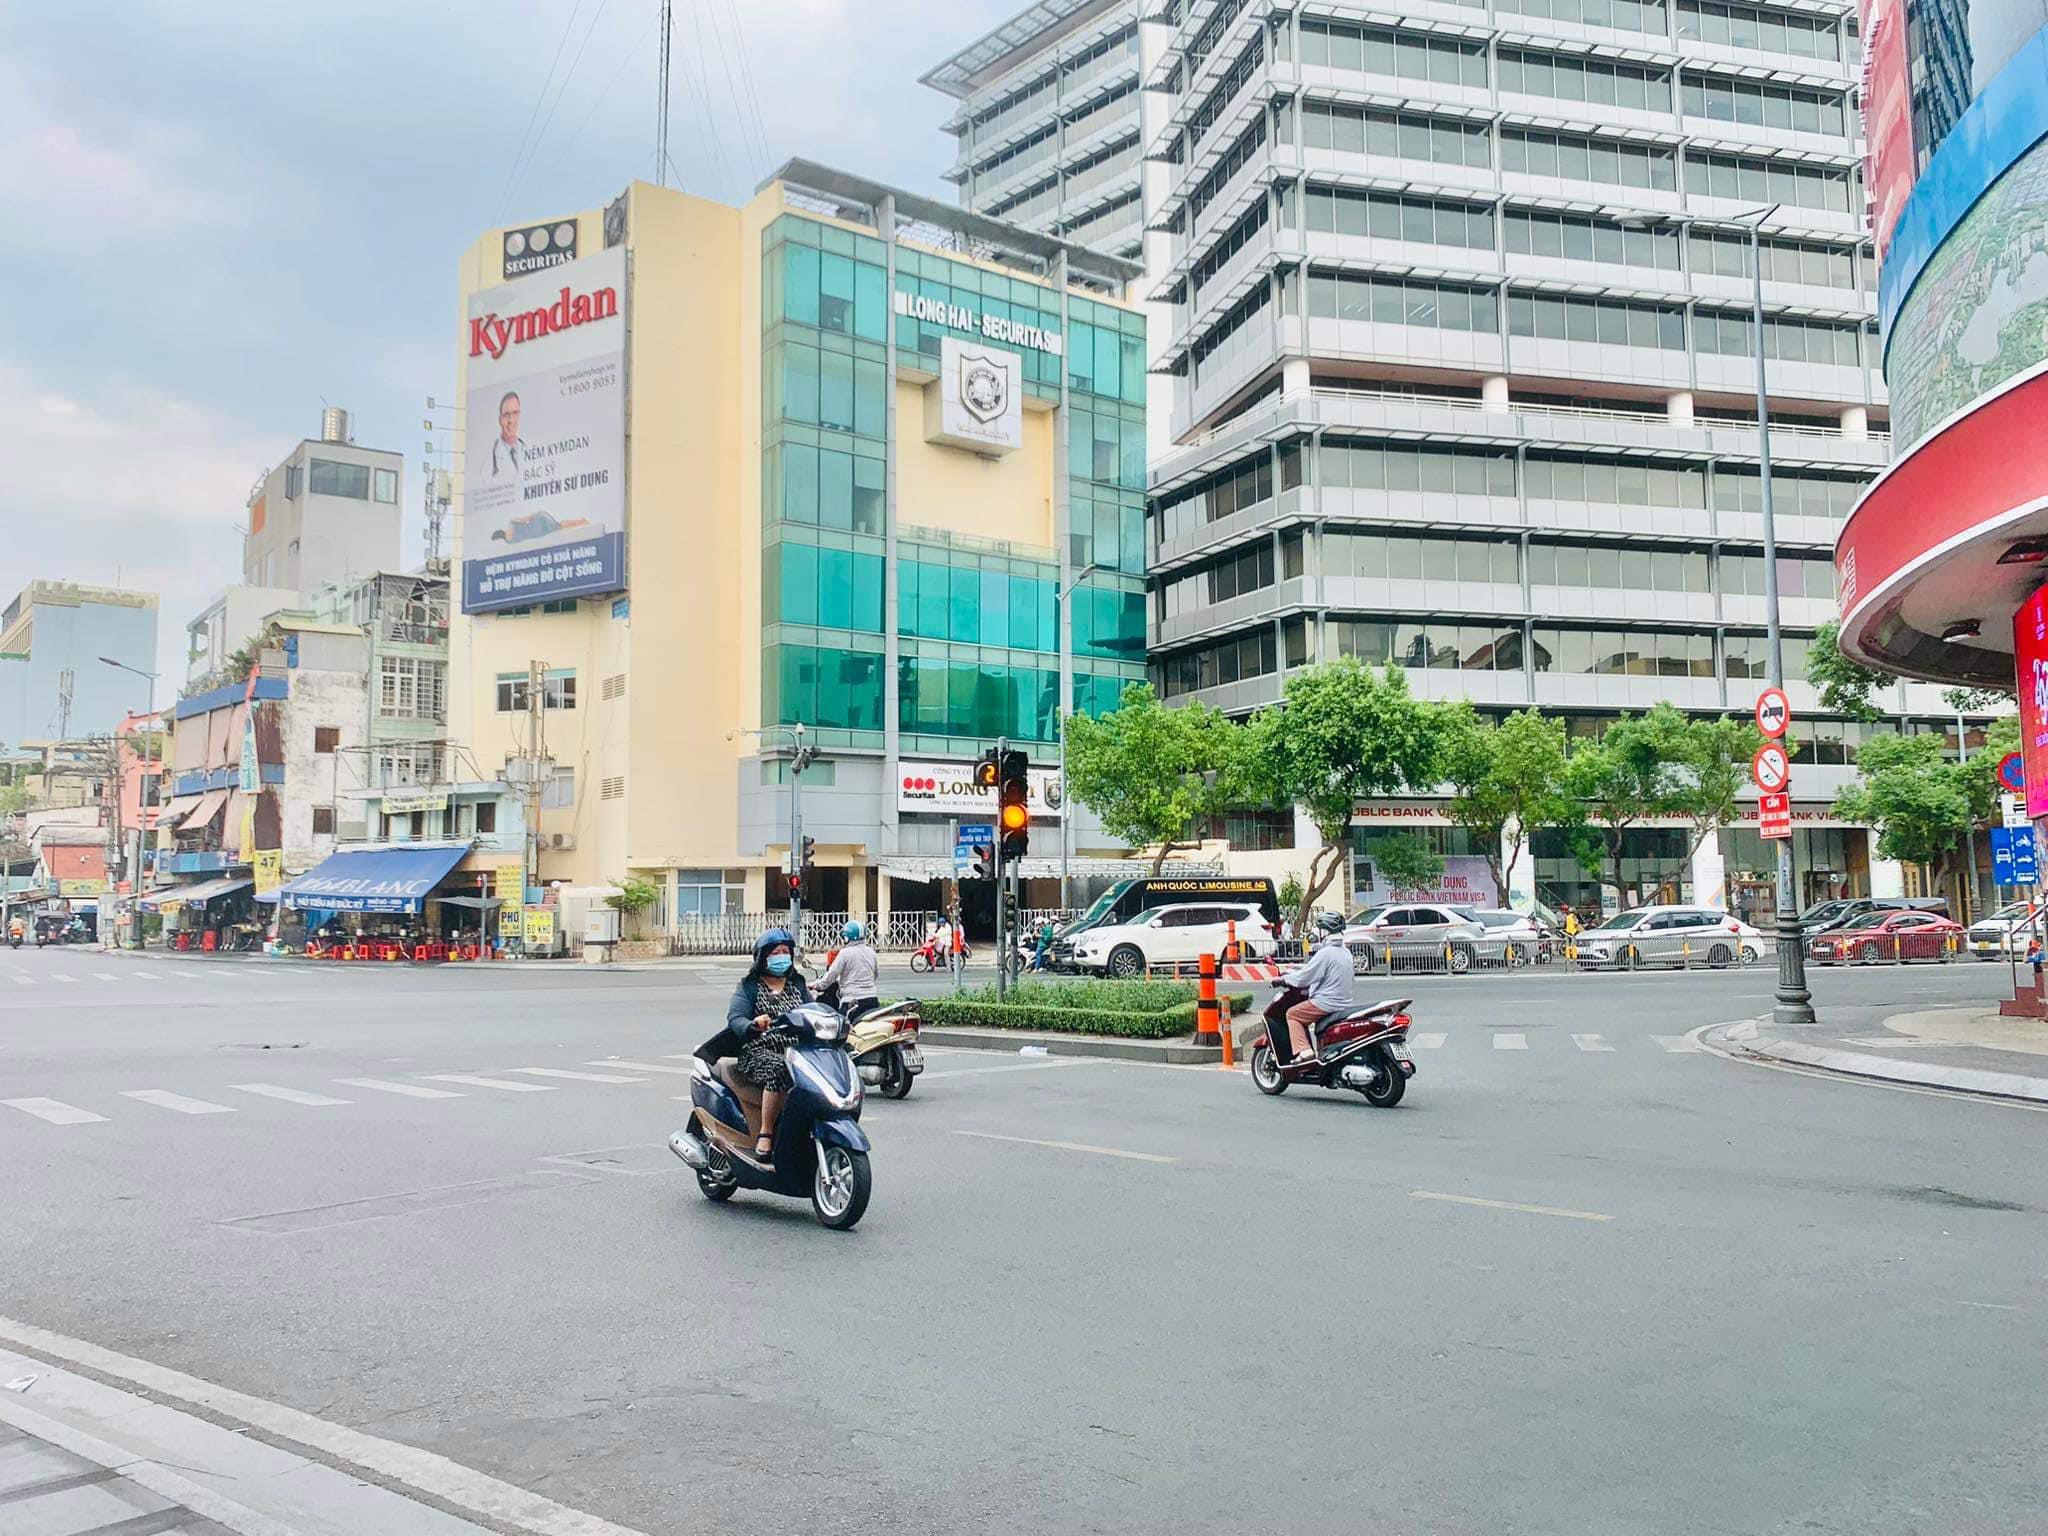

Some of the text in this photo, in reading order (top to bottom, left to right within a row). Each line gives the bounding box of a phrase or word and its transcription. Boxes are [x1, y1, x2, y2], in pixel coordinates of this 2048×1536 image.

[505, 251, 574, 274] SECURITAS
[469, 286, 618, 360] Kymdan
[908, 293, 946, 324] LONG
[948, 304, 973, 331] HAI
[982, 313, 1052, 351] SECURITAS
[548, 435, 590, 457] KYMDAN
[581, 469, 609, 490] DỤNG
[505, 556, 540, 572] KYMDAN
[903, 791, 936, 799] Securitas
[939, 781, 988, 797] LONG
[1352, 807, 1391, 817] UBLIC
[1393, 807, 1434, 817] BANK
[260, 856, 277, 869] 47
[1200, 882, 1252, 890] LIMOUSINE
[1416, 891, 1436, 902] BANK
[1437, 891, 1469, 902] VIETNAM
[1470, 891, 1487, 902] VISA
